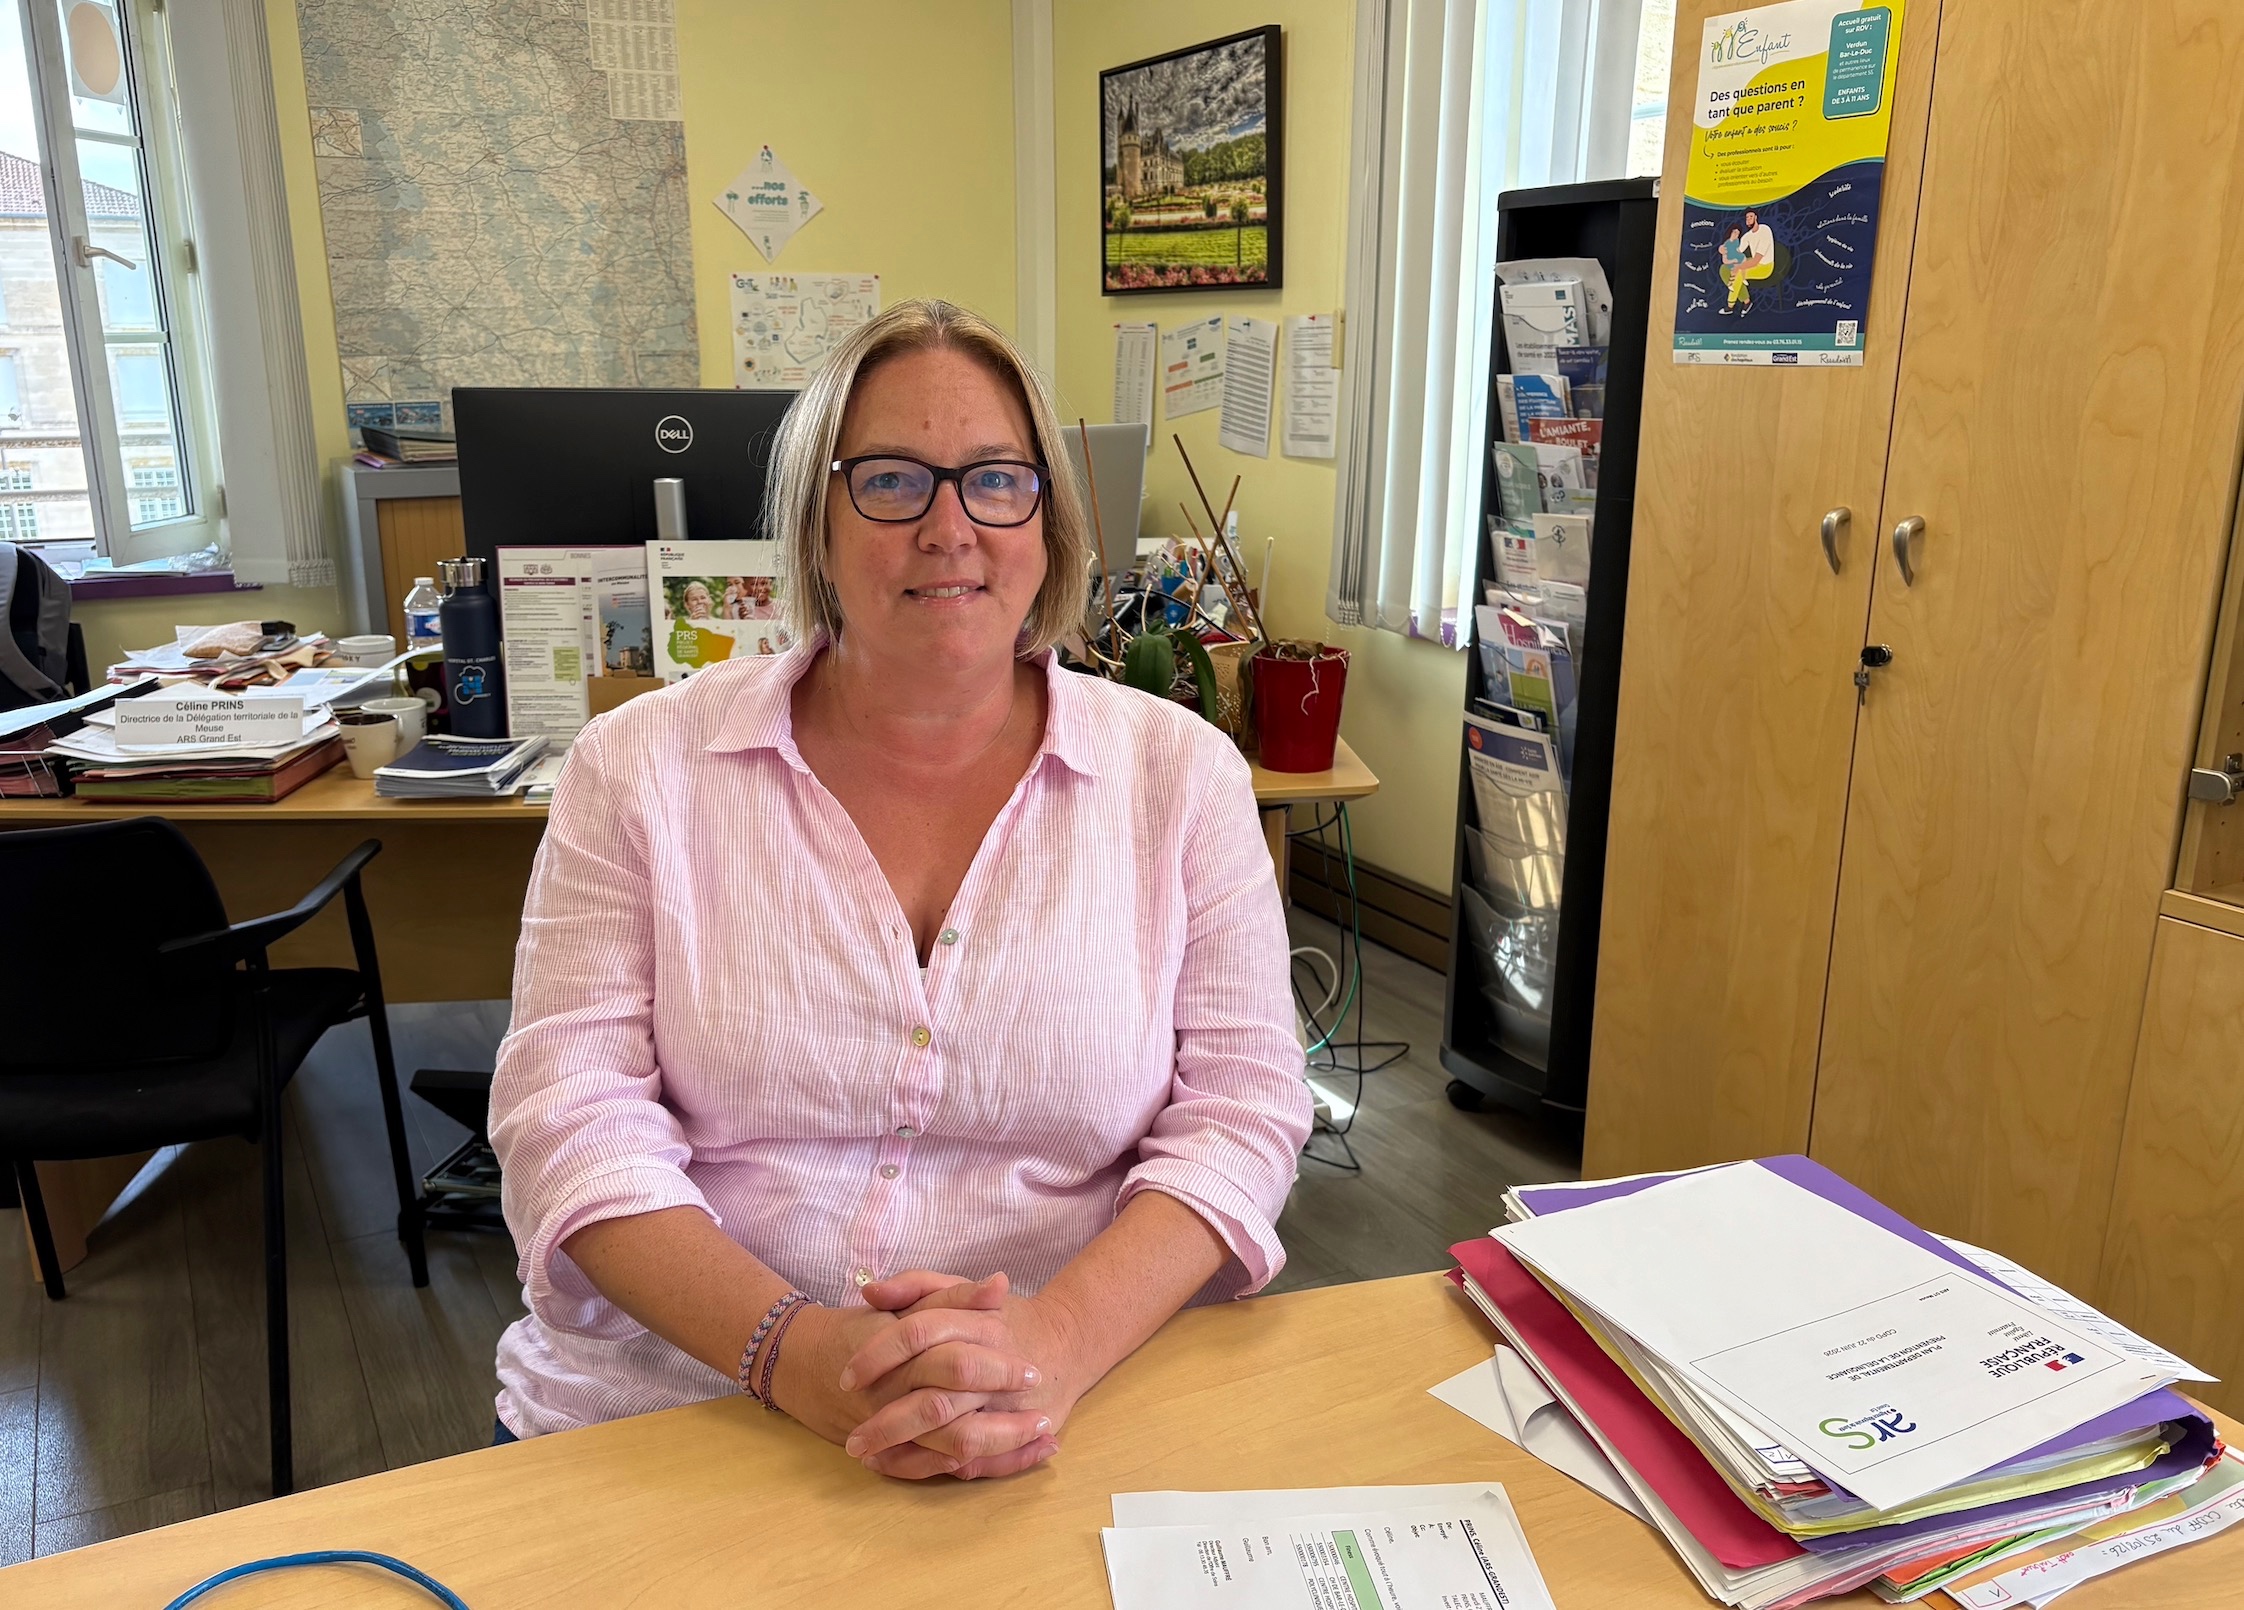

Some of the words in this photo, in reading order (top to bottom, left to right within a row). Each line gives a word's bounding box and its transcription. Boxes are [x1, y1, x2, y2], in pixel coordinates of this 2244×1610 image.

[1838, 18, 1861, 27] Accueil
[1860, 14, 1882, 25] gratuit
[1855, 24, 1870, 32] RDV
[1845, 41, 1868, 49] Verdun
[1839, 48, 1873, 59] Bar-Le-Duc
[1709, 91, 1731, 103] Des
[1732, 82, 1788, 102] questions
[1790, 79, 1806, 91] en
[1837, 86, 1866, 96] ENFANTS
[1831, 97, 1841, 105] DE
[1856, 93, 1870, 101] ANS
[1707, 106, 1731, 120] tant
[1732, 104, 1755, 119] que
[1756, 97, 1795, 116] parent
[1797, 95, 1805, 107] ?
[1704, 128, 1723, 143] Votre
[1723, 124, 1749, 140] enfant
[1753, 123, 1767, 137] des
[1767, 122, 1791, 134] soucis
[1726, 146, 1762, 158] professionnels
[1761, 145, 1773, 153] sont
[1779, 144, 1793, 152] pour
[747, 193, 789, 206] efforts
[660, 429, 690, 440] DELL
[676, 629, 699, 641] PRS
[176, 701, 209, 711] Céline
[211, 700, 244, 711] PRINS
[120, 714, 161, 724] Directrice
[162, 714, 174, 723] de
[175, 713, 185, 722] la
[186, 712, 231, 724] Délégation
[233, 711, 276, 721] territoriale
[277, 711, 289, 720] de
[290, 710, 299, 719] la
[195, 724, 225, 733] Meuse
[176, 735, 197, 744] ARS
[199, 734, 225, 744] Grand
[227, 733, 242, 743] Est
[1987, 1320, 2018, 1338] Fraternité
[2003, 1325, 2026, 1339] Égalité
[2012, 1330, 2034, 1343] Liberté
[1840, 1342, 1857, 1352] JUIN
[1898, 1334, 1947, 1357] PREVENTION
[1923, 1344, 1944, 1357] PLAN
[1979, 1335, 2053, 1370] FRANÇAISE
[1886, 1351, 1901, 1361] DE
[1988, 1343, 2067, 1379] RÉPUBLIQUE
[1825, 1359, 1880, 1381] DELINQUANCE
[1864, 1351, 1923, 1378] DEPARTEMENTAL
[1847, 1373, 1863, 1382] DE
[1202, 1540, 1211, 1556] Direction
[1208, 1540, 1217, 1557] Directeur
[1242, 1537, 1255, 1562] Guillaume
[1344, 1544, 1354, 1560] Finess
[1364, 1528, 1377, 1548] Comme
[1371, 1547, 1386, 1566] évoqué
[1379, 1565, 1389, 1578] tout
[1214, 1539, 1225, 1561] Guillaume
[1220, 1560, 1232, 1581] MAUFFRÉ
[1472, 1538, 1485, 1556] Céline
[1480, 1555, 1510, 1605] (ARS-GRANDEST)
[1318, 1577, 1330, 1595] CENTRE
[1339, 1575, 1351, 1594] CENTRE
